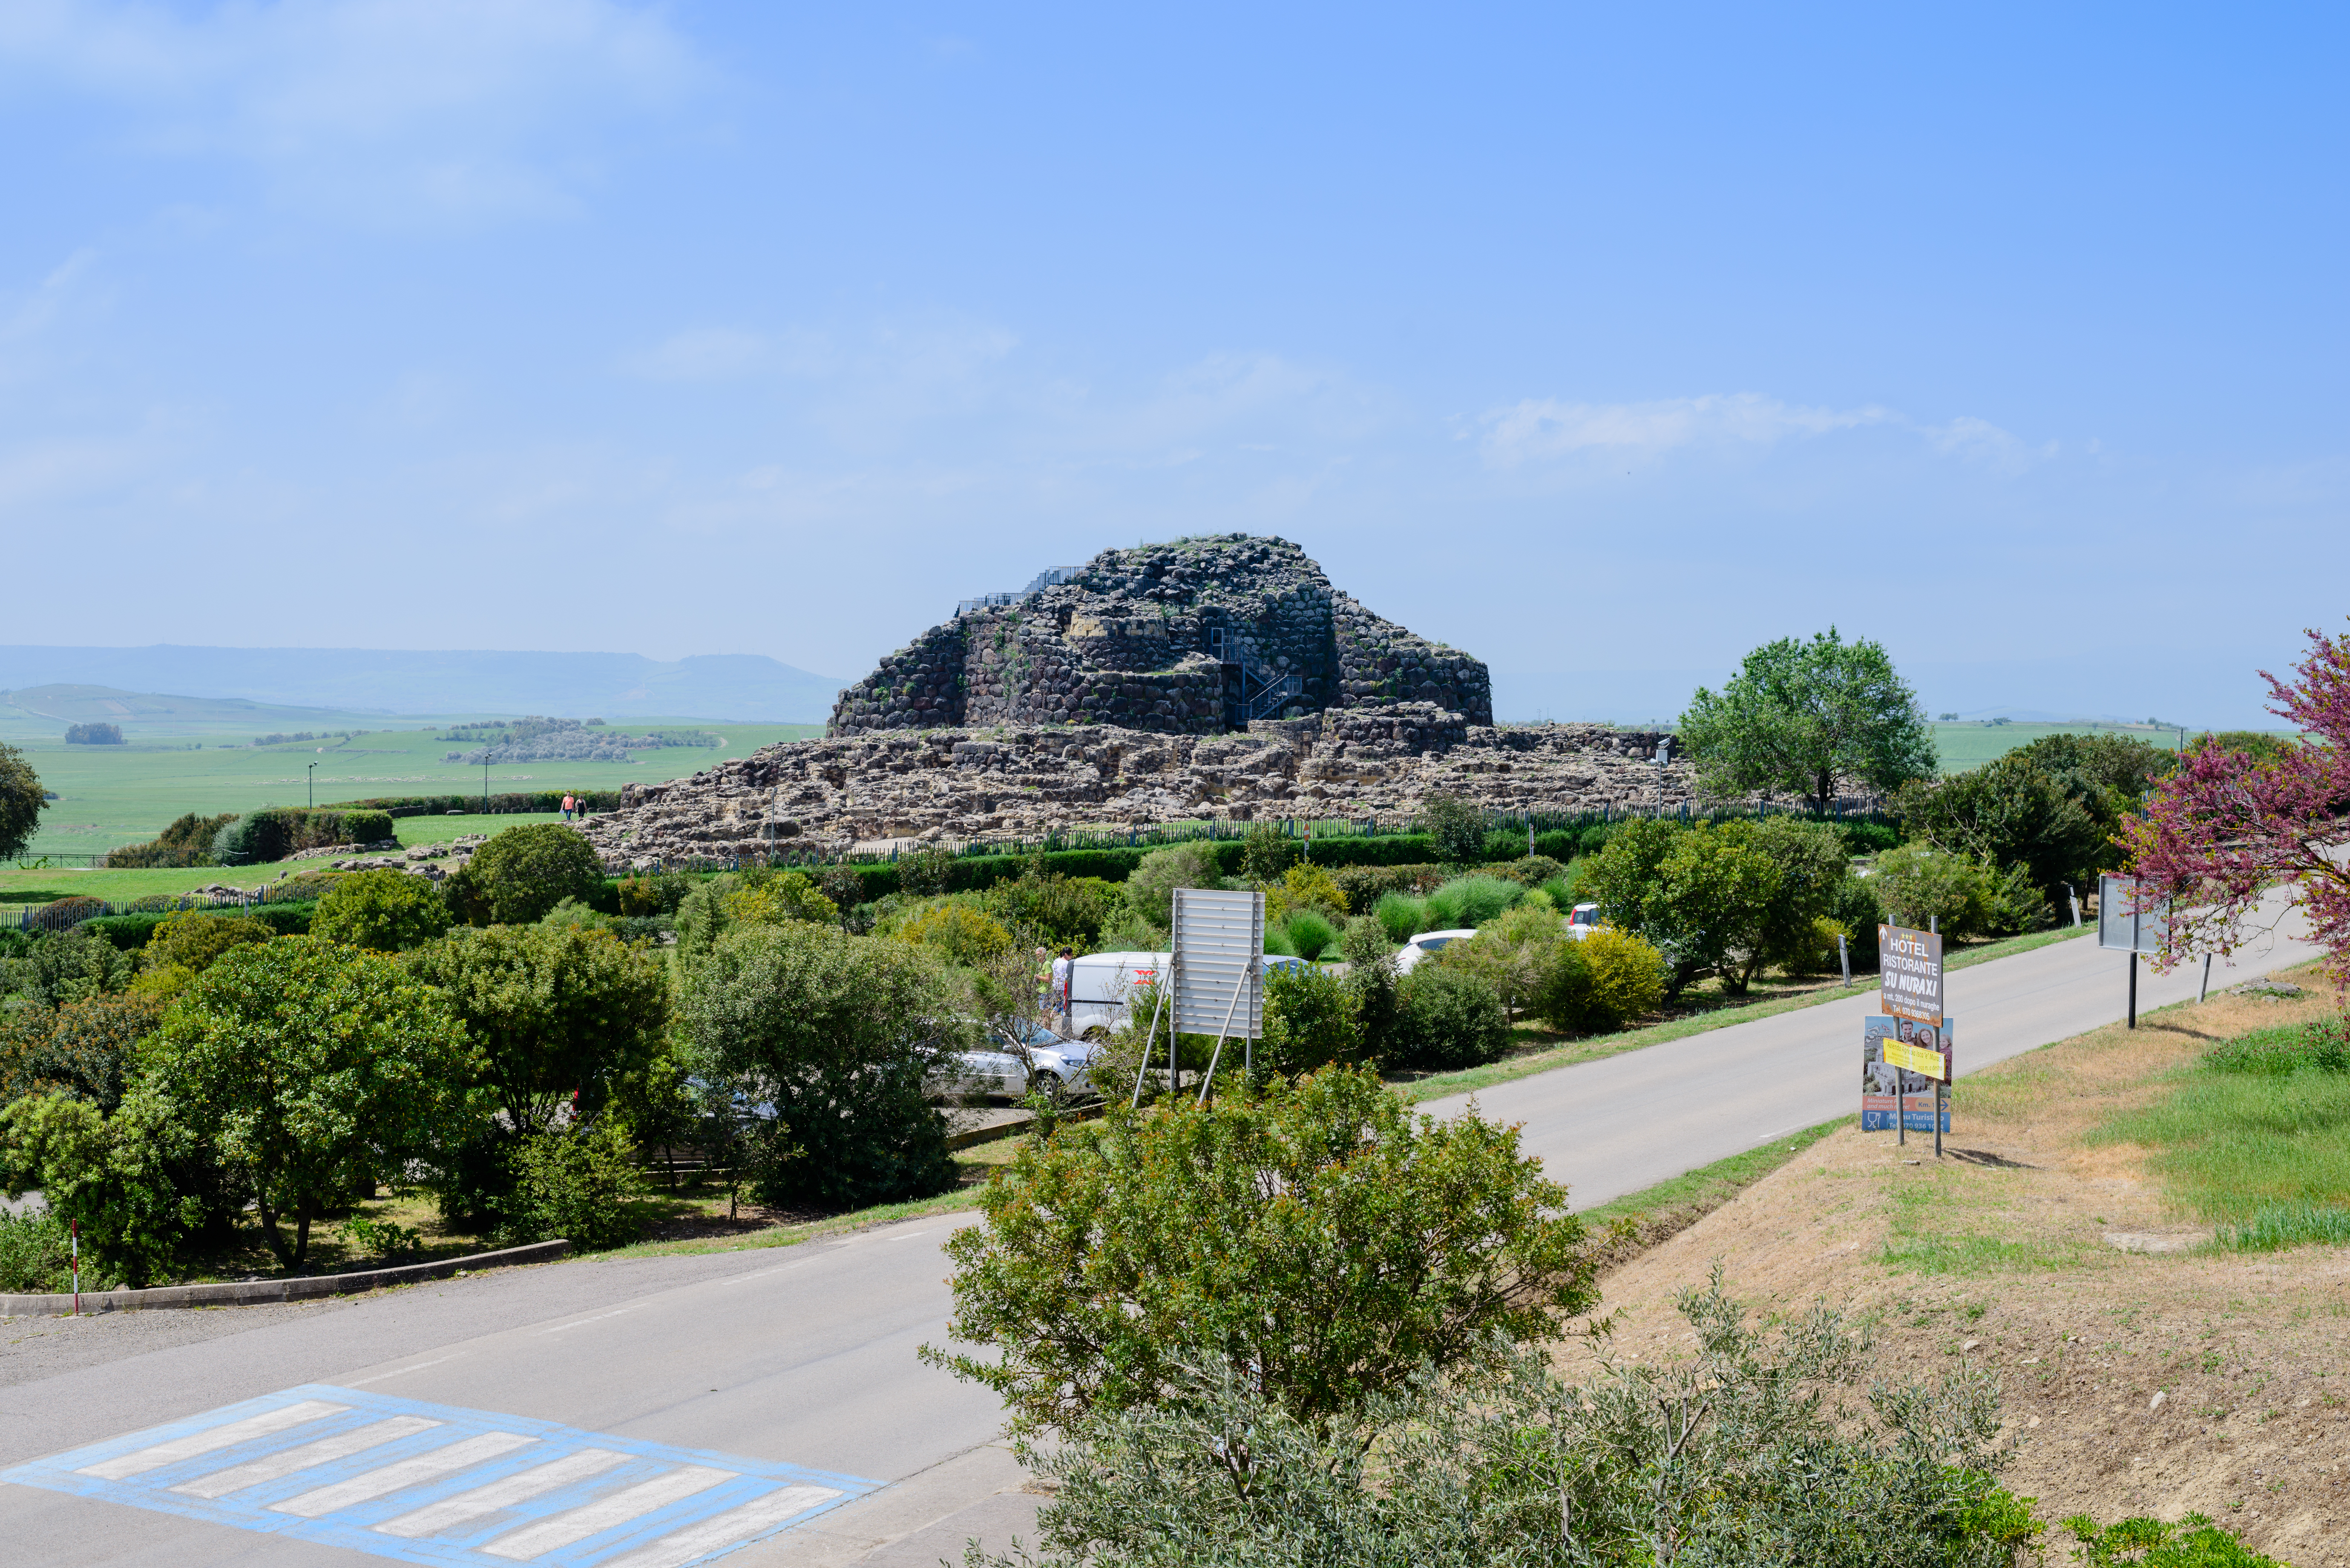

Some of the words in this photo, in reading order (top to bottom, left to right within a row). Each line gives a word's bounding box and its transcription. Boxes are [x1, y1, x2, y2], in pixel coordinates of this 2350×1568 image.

[1890, 938, 1929, 957] HOTEL
[1883, 953, 1938, 976] RISTORANTE
[1884, 971, 1897, 988] SU
[1898, 974, 1937, 997] NURAXI
[1895, 994, 1903, 1003] 200
[1904, 996, 1916, 1006] dopo
[1916, 998, 1920, 1007] il
[1920, 1001, 1940, 1011] nuraghe
[1893, 1005, 1901, 1014] Tel.
[1902, 1007, 1910, 1016] 070
[1911, 1009, 1930, 1021] 9368305
[1887, 1042, 1901, 1051] Azienda
[1901, 1046, 1916, 1056] Agricola
[1930, 1054, 1941, 1062] Muras
